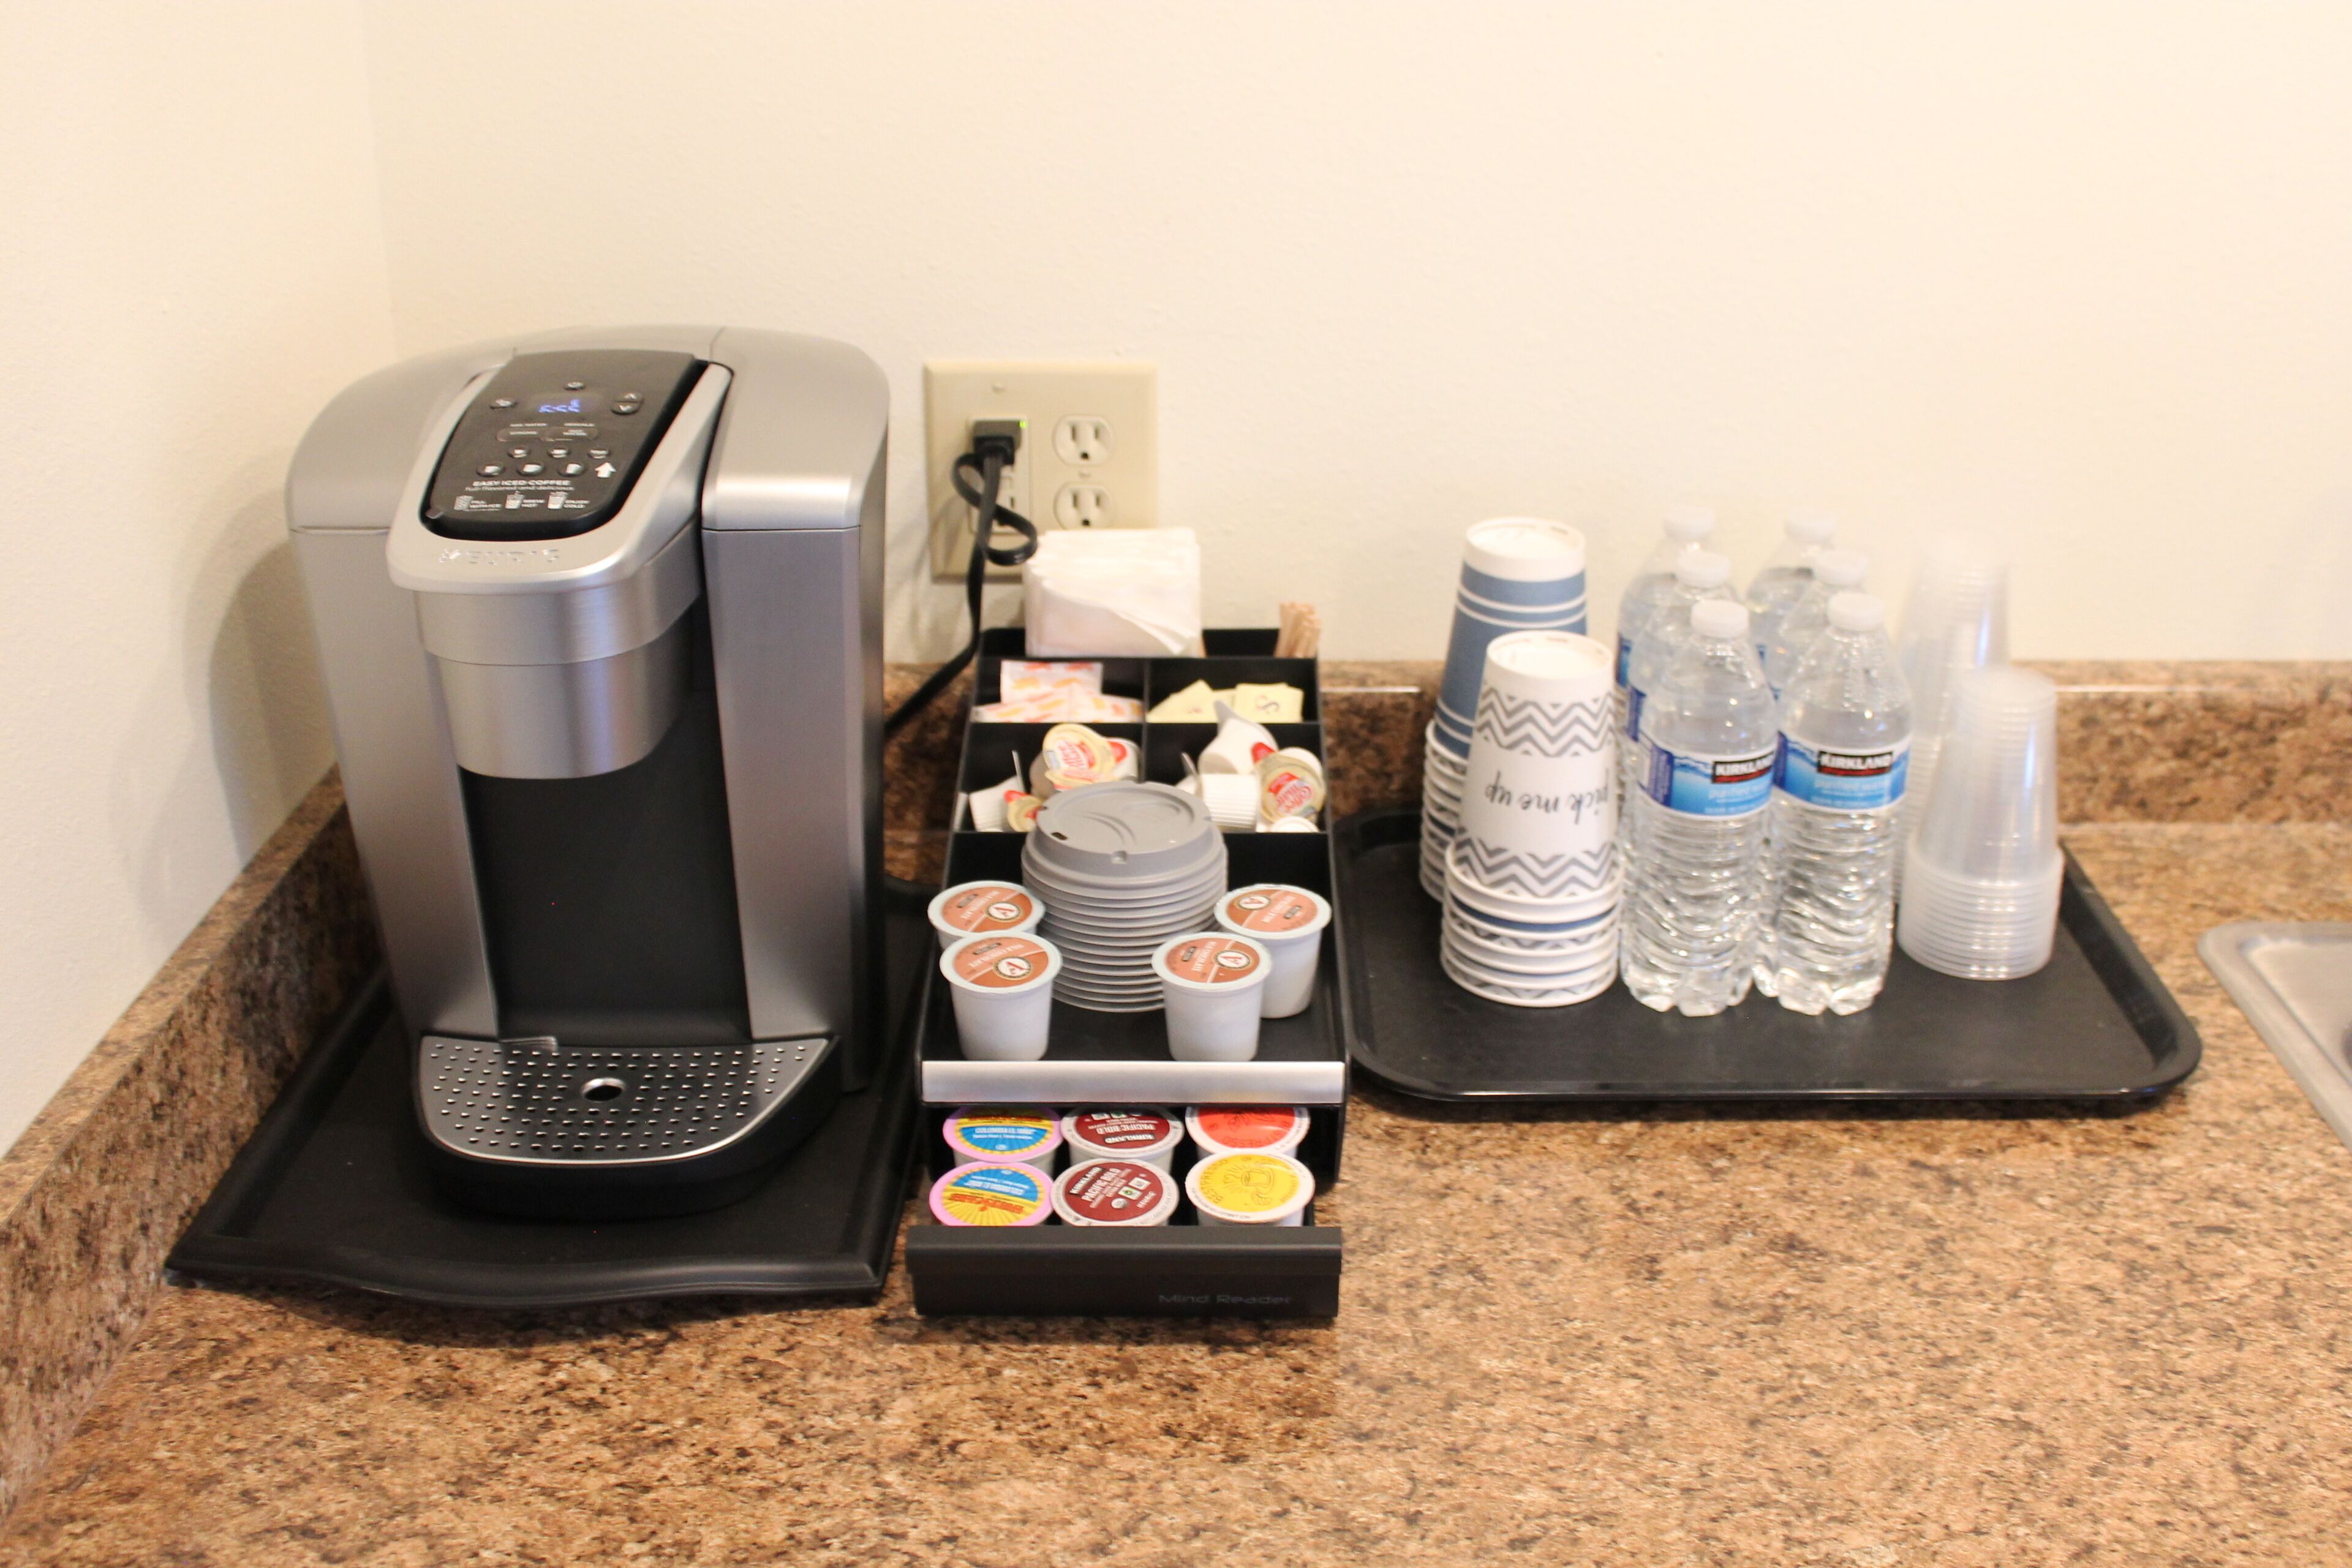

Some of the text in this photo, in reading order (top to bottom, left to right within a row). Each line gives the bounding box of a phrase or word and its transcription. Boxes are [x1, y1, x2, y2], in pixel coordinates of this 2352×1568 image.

[1820, 753, 1892, 770] KIRKLAND
[1484, 770, 1512, 806] up
[1518, 794, 1559, 813] me
[1096, 1125, 1120, 1135] BOLD
[1121, 1123, 1156, 1132] PACIFIC
[1104, 1133, 1156, 1144] KIRKLAND
[1069, 1166, 1102, 1194] KIRKLAND
[1081, 1178, 1110, 1202] PACIFIC
[1099, 1167, 1121, 1182] BOLD
[1199, 1159, 1229, 1204] BESTPRESSO
[1158, 1294, 1291, 1304] Mind Reader
